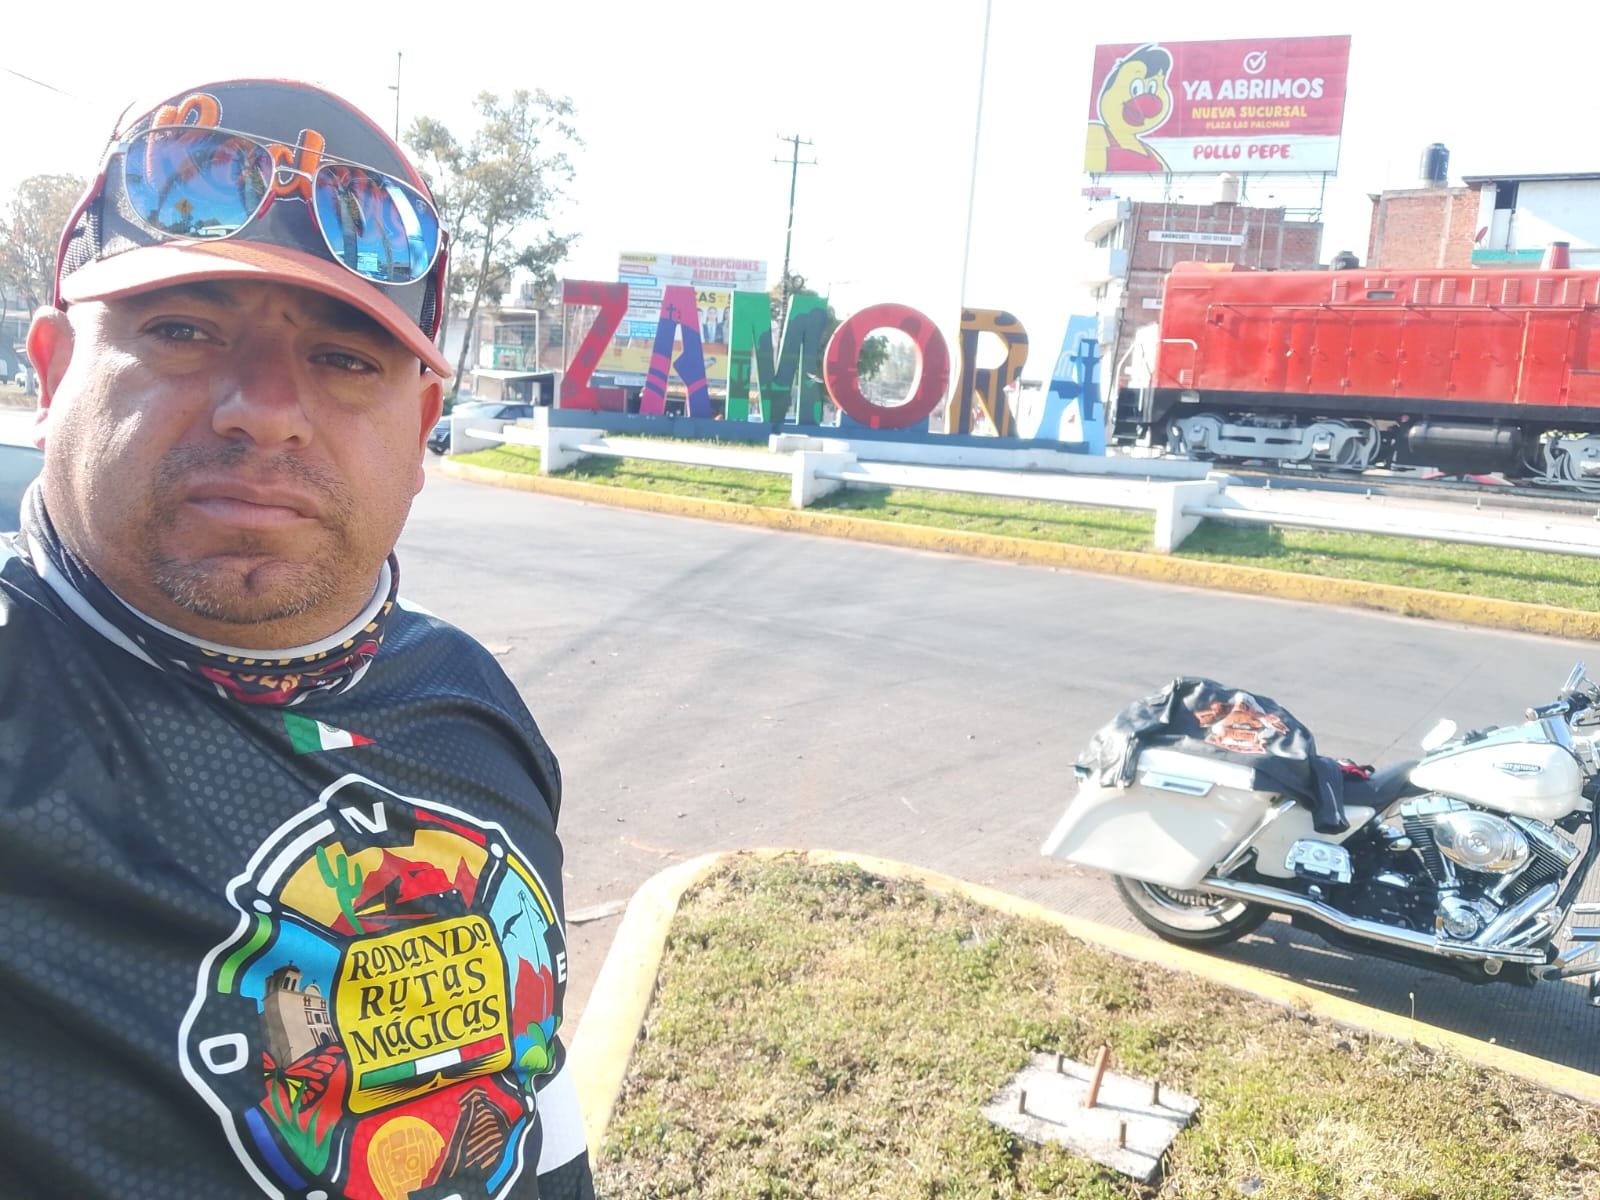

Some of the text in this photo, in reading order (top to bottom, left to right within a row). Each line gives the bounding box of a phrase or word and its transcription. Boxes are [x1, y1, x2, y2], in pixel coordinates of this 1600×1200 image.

[1182, 78, 1325, 101] YA ABRIMOS
[1191, 105, 1307, 119] NUEVA SUCURSAL
[1193, 144, 1291, 160] POLLO PEPE
[692, 268, 737, 281] ABIERTAS
[560, 280, 1106, 453] ZAMORA
[339, 801, 388, 834] N
